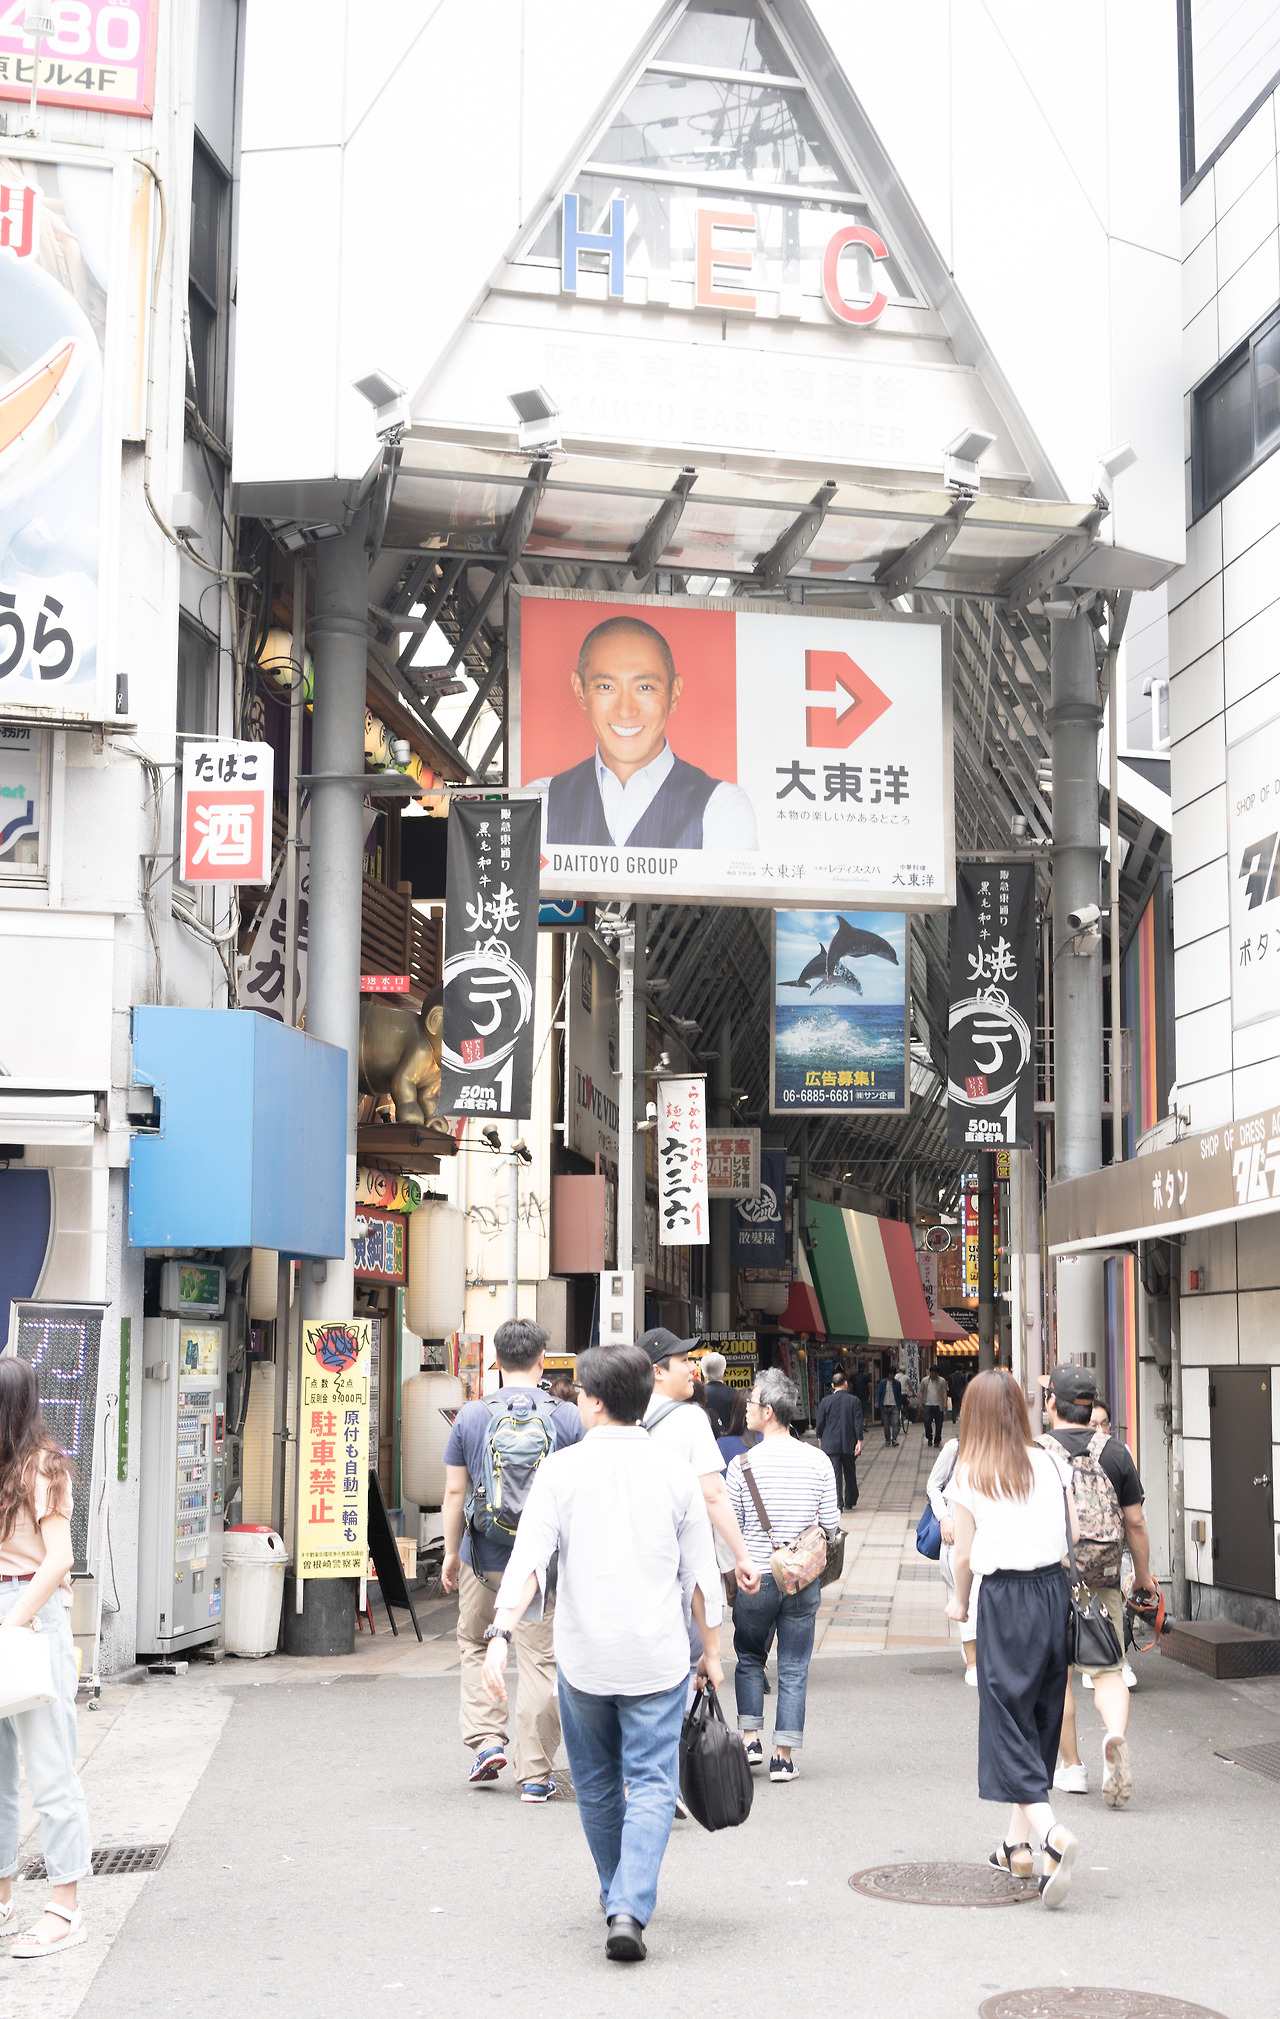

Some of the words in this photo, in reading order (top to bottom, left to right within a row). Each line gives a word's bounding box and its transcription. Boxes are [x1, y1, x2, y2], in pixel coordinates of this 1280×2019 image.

[691, 407, 770, 437] EAST
[785, 416, 908, 450] CENTER
[194, 752, 259, 783] たばこ
[775, 760, 910, 805] 大東洋
[1236, 793, 1256, 817] SHOP
[1260, 784, 1270, 803] OF
[775, 809, 911, 826] 本物の楽しいがあるところ
[191, 804, 256, 866] 酒
[476, 821, 492, 888] 黒毛和牛
[553, 854, 619, 873] DAITOYO
[626, 857, 679, 875] GROUP
[761, 863, 806, 879] 大東洋
[891, 872, 935, 888] 大東洋
[978, 881, 992, 940] 黒毛和牛
[367, 977, 405, 985] 送水口
[459, 1084, 495, 1099] 50m
[805, 1071, 876, 1087] 広告募集!
[783, 1089, 853, 1102] 06-6885-6681
[965, 1132, 1004, 1143] 直進右角
[968, 1119, 1002, 1132] 50m
[1200, 1134, 1219, 1160] SHOP
[1224, 1128, 1234, 1152] OF
[1239, 1117, 1266, 1146] DRESS
[733, 1157, 741, 1188] レンタル
[1152, 1169, 1188, 1211] ボタン
[309, 1410, 337, 1524] 駐車禁止
[342, 1410, 360, 1542] 原付も自動二輪も
